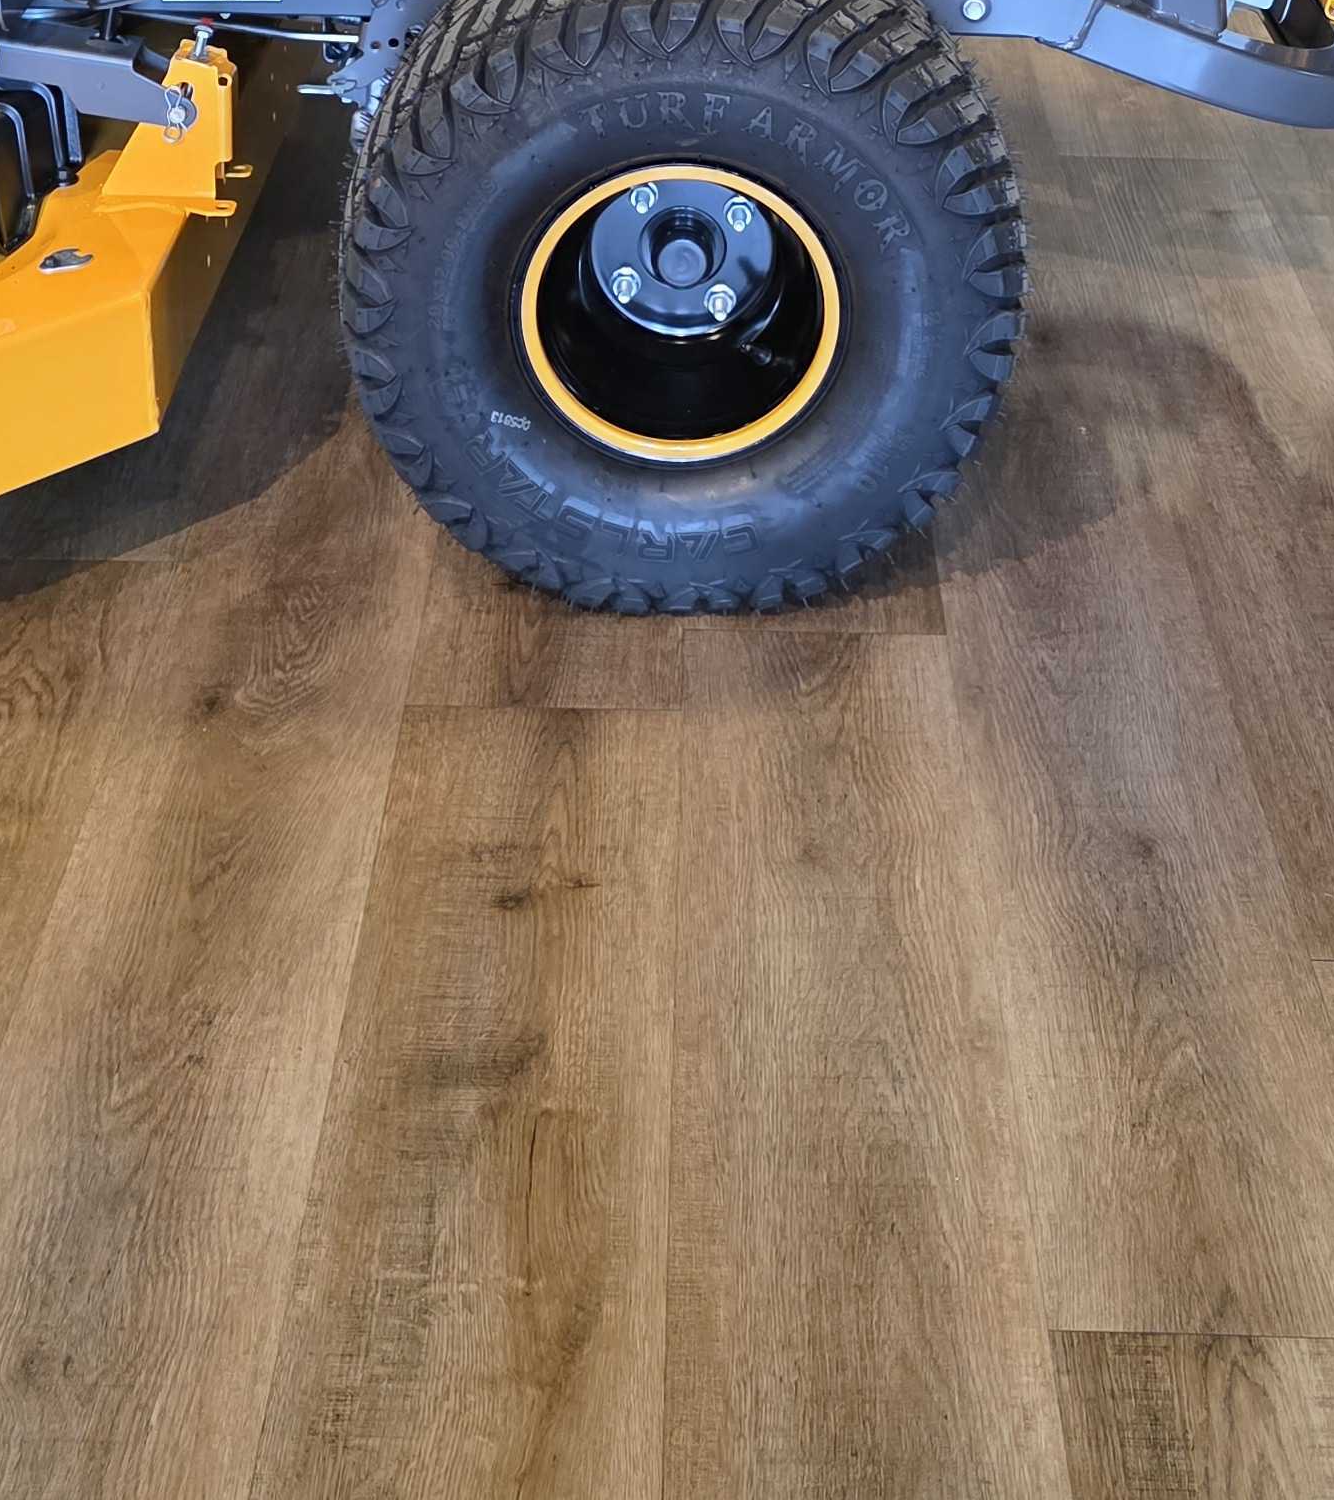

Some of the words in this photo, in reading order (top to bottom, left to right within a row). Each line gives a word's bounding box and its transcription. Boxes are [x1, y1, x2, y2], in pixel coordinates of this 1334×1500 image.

[579, 91, 731, 139] TURF
[741, 106, 912, 251] ARMOR
[466, 427, 759, 564] CARLSTAR
